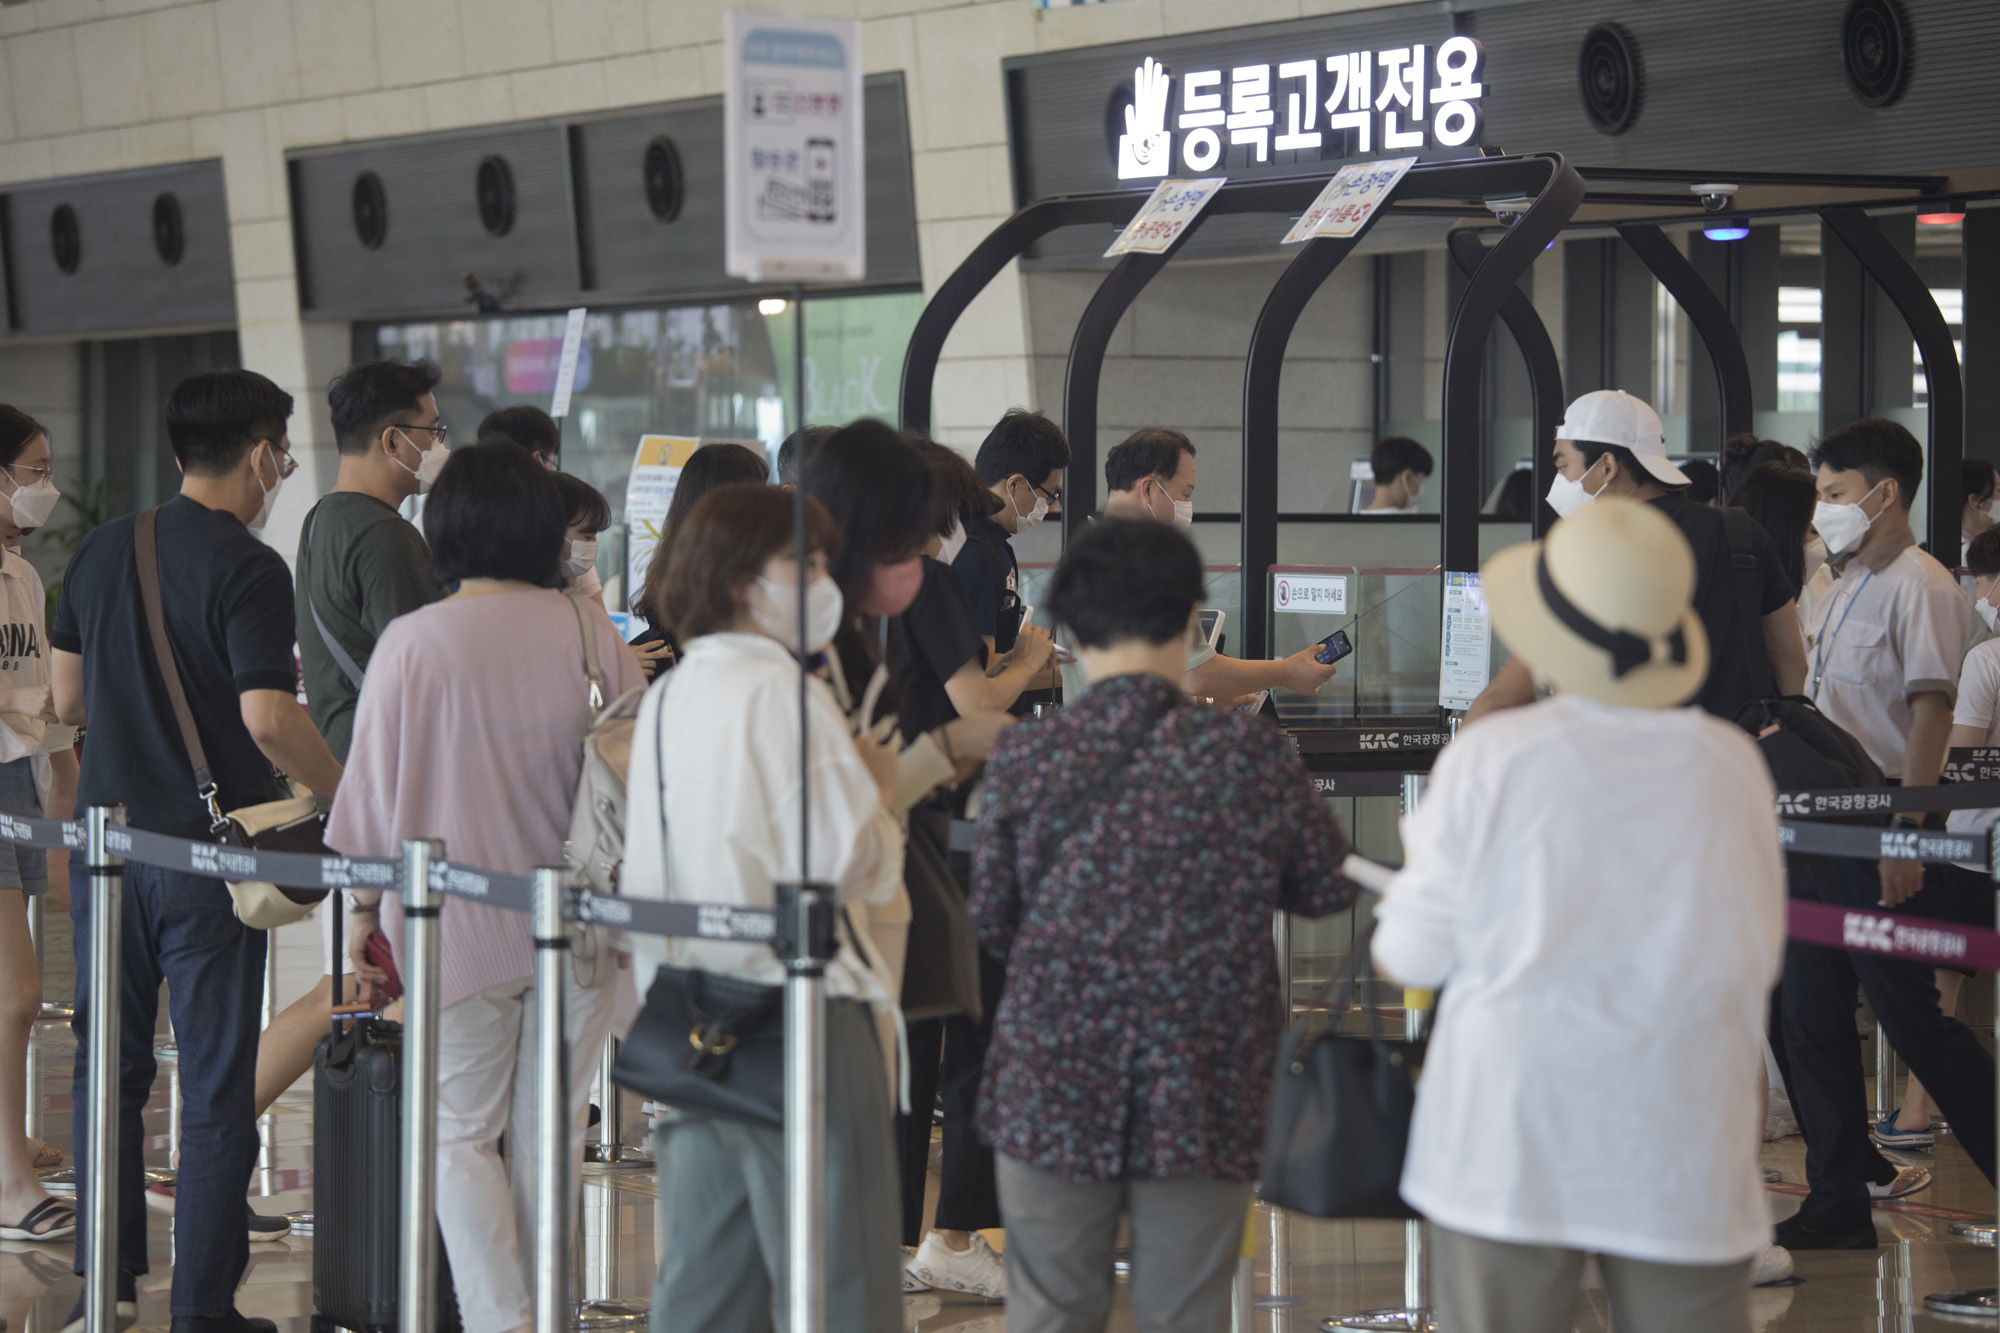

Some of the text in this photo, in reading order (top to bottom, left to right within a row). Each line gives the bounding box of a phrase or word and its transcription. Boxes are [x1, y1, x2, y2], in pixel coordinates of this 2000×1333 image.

[1178, 36, 1482, 172] 등록고객전용
[1291, 587, 1343, 602] 손으로 밀지 마세요
[1359, 732, 1399, 750] KAC
[1814, 793, 1892, 811] 한국공항공사
[1880, 832, 1974, 859] KAC 한국공항공사
[1843, 912, 1895, 952] KAC
